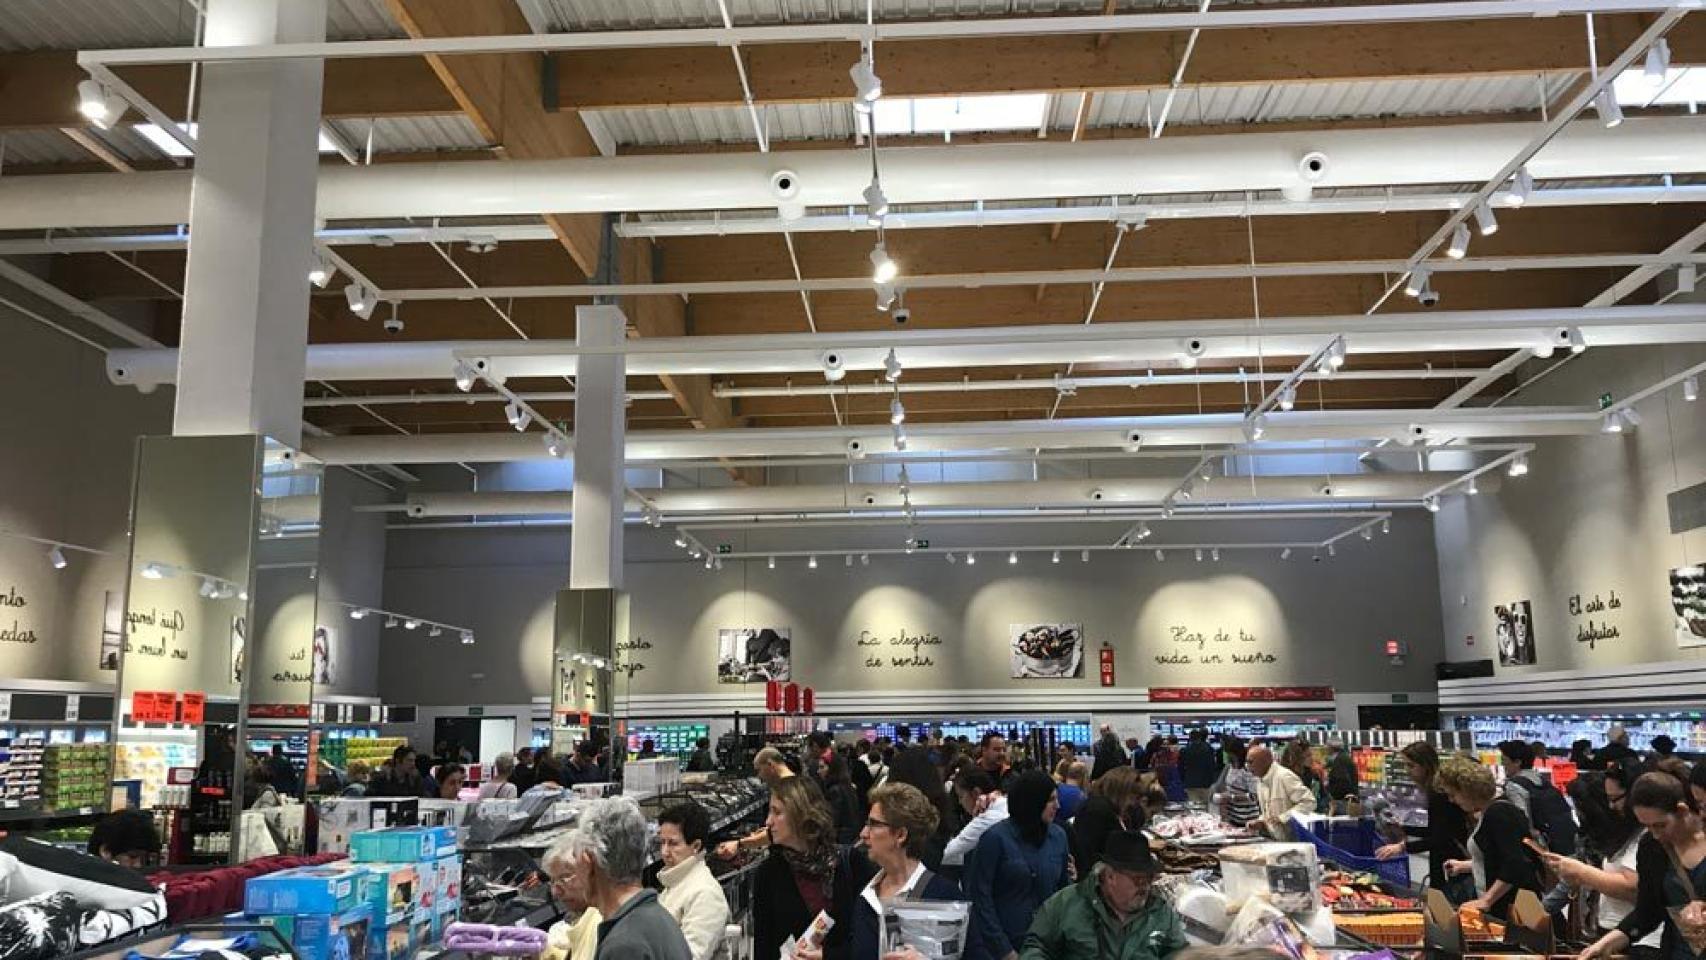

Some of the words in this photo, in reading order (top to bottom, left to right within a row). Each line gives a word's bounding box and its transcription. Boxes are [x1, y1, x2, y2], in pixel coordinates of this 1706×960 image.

[1569, 594, 1582, 616] El
[1608, 590, 1622, 609] de
[858, 630, 881, 646] La
[1170, 626, 1206, 649] Haz
[1214, 627, 1231, 642] de
[1239, 628, 1257, 642] tu
[865, 654, 882, 667] de
[892, 655, 934, 667] sentir
[1155, 649, 1192, 664] vida
[1200, 654, 1223, 664] un
[1232, 651, 1277, 664] sueño
